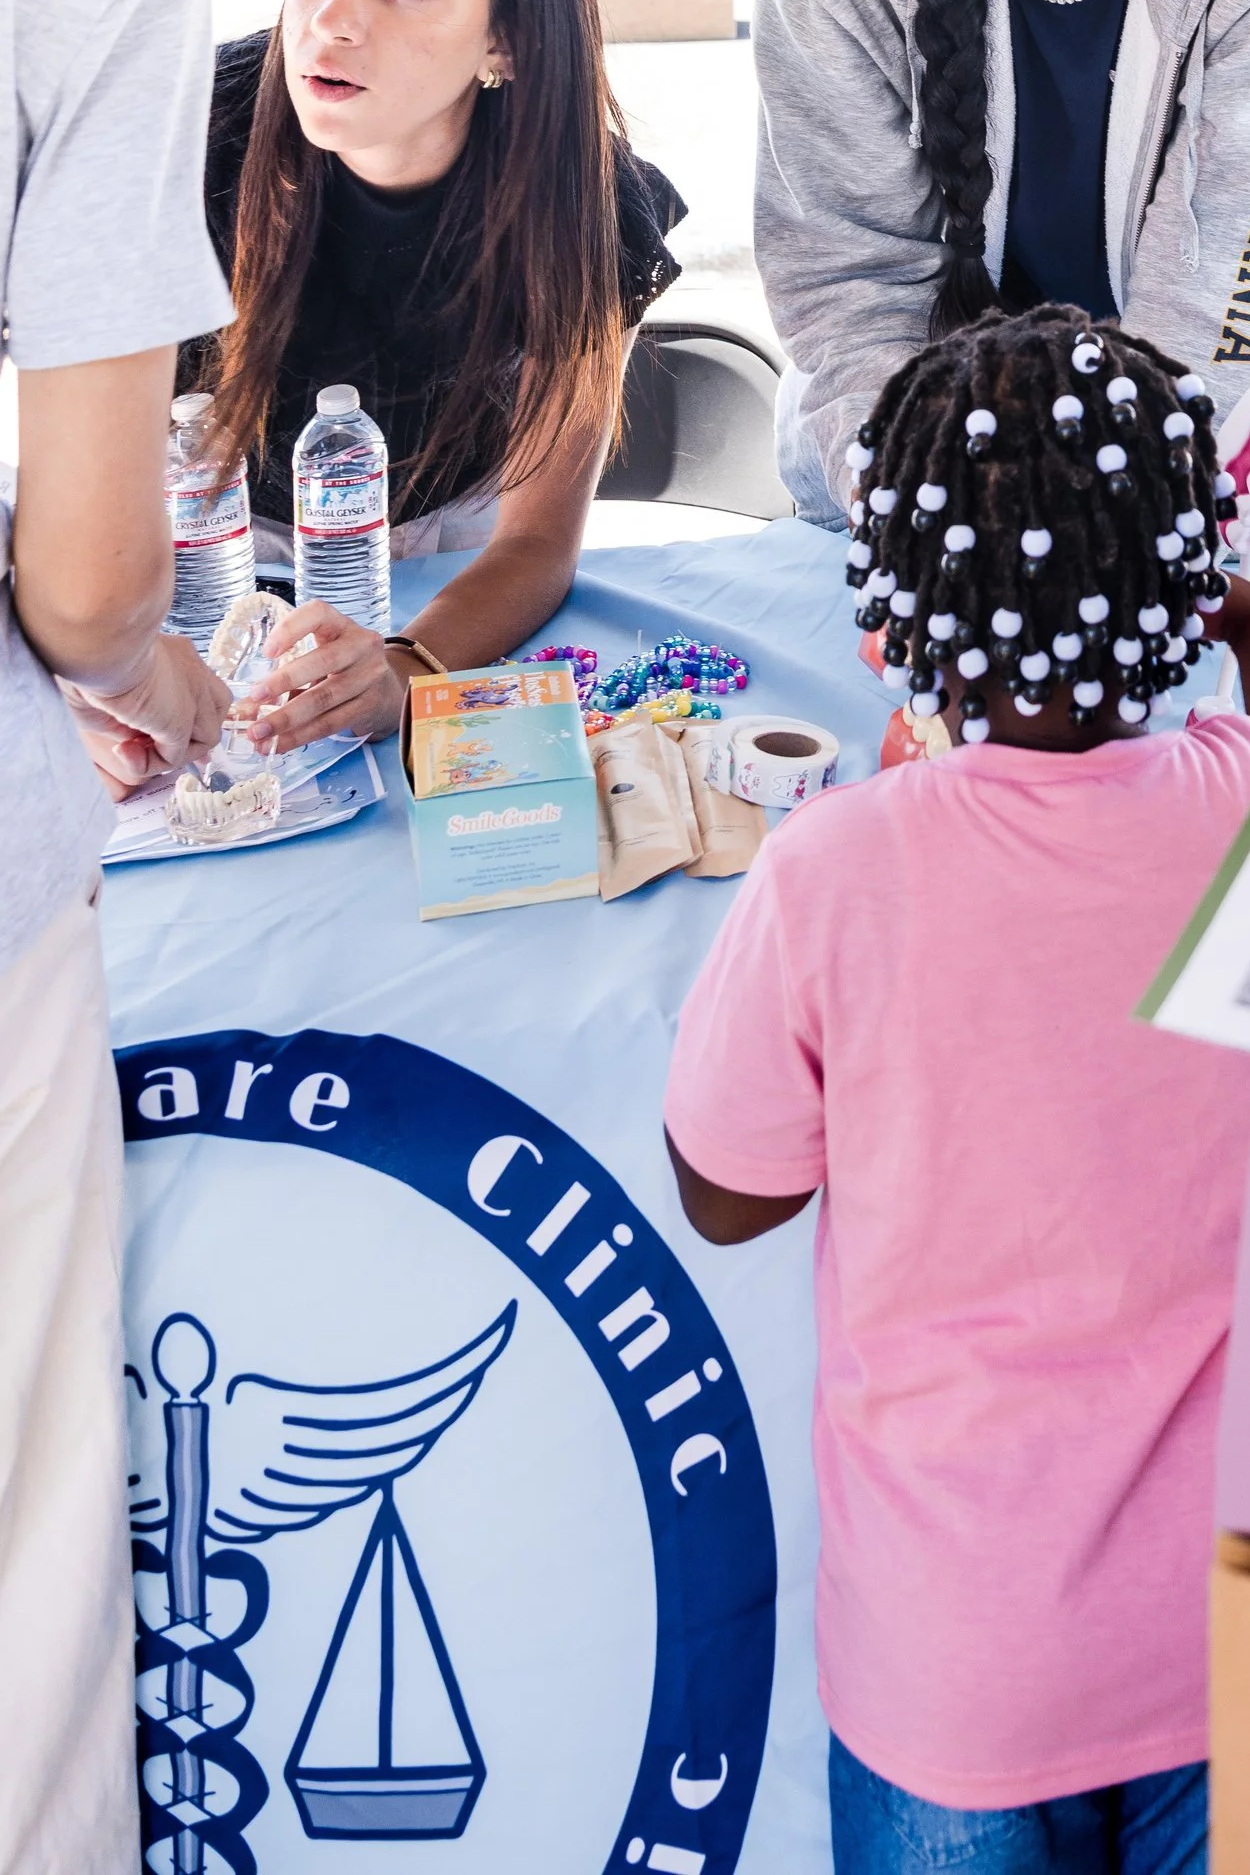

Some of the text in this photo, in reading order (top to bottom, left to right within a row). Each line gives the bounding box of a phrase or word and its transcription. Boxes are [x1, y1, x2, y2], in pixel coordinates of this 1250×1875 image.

[176, 512, 239, 530] CRYSTAL GEYSER
[305, 507, 366, 517] CRYSTAL GEYSER
[449, 805, 561, 835] SmileGoods
[467, 1134, 728, 1498] Clinic
